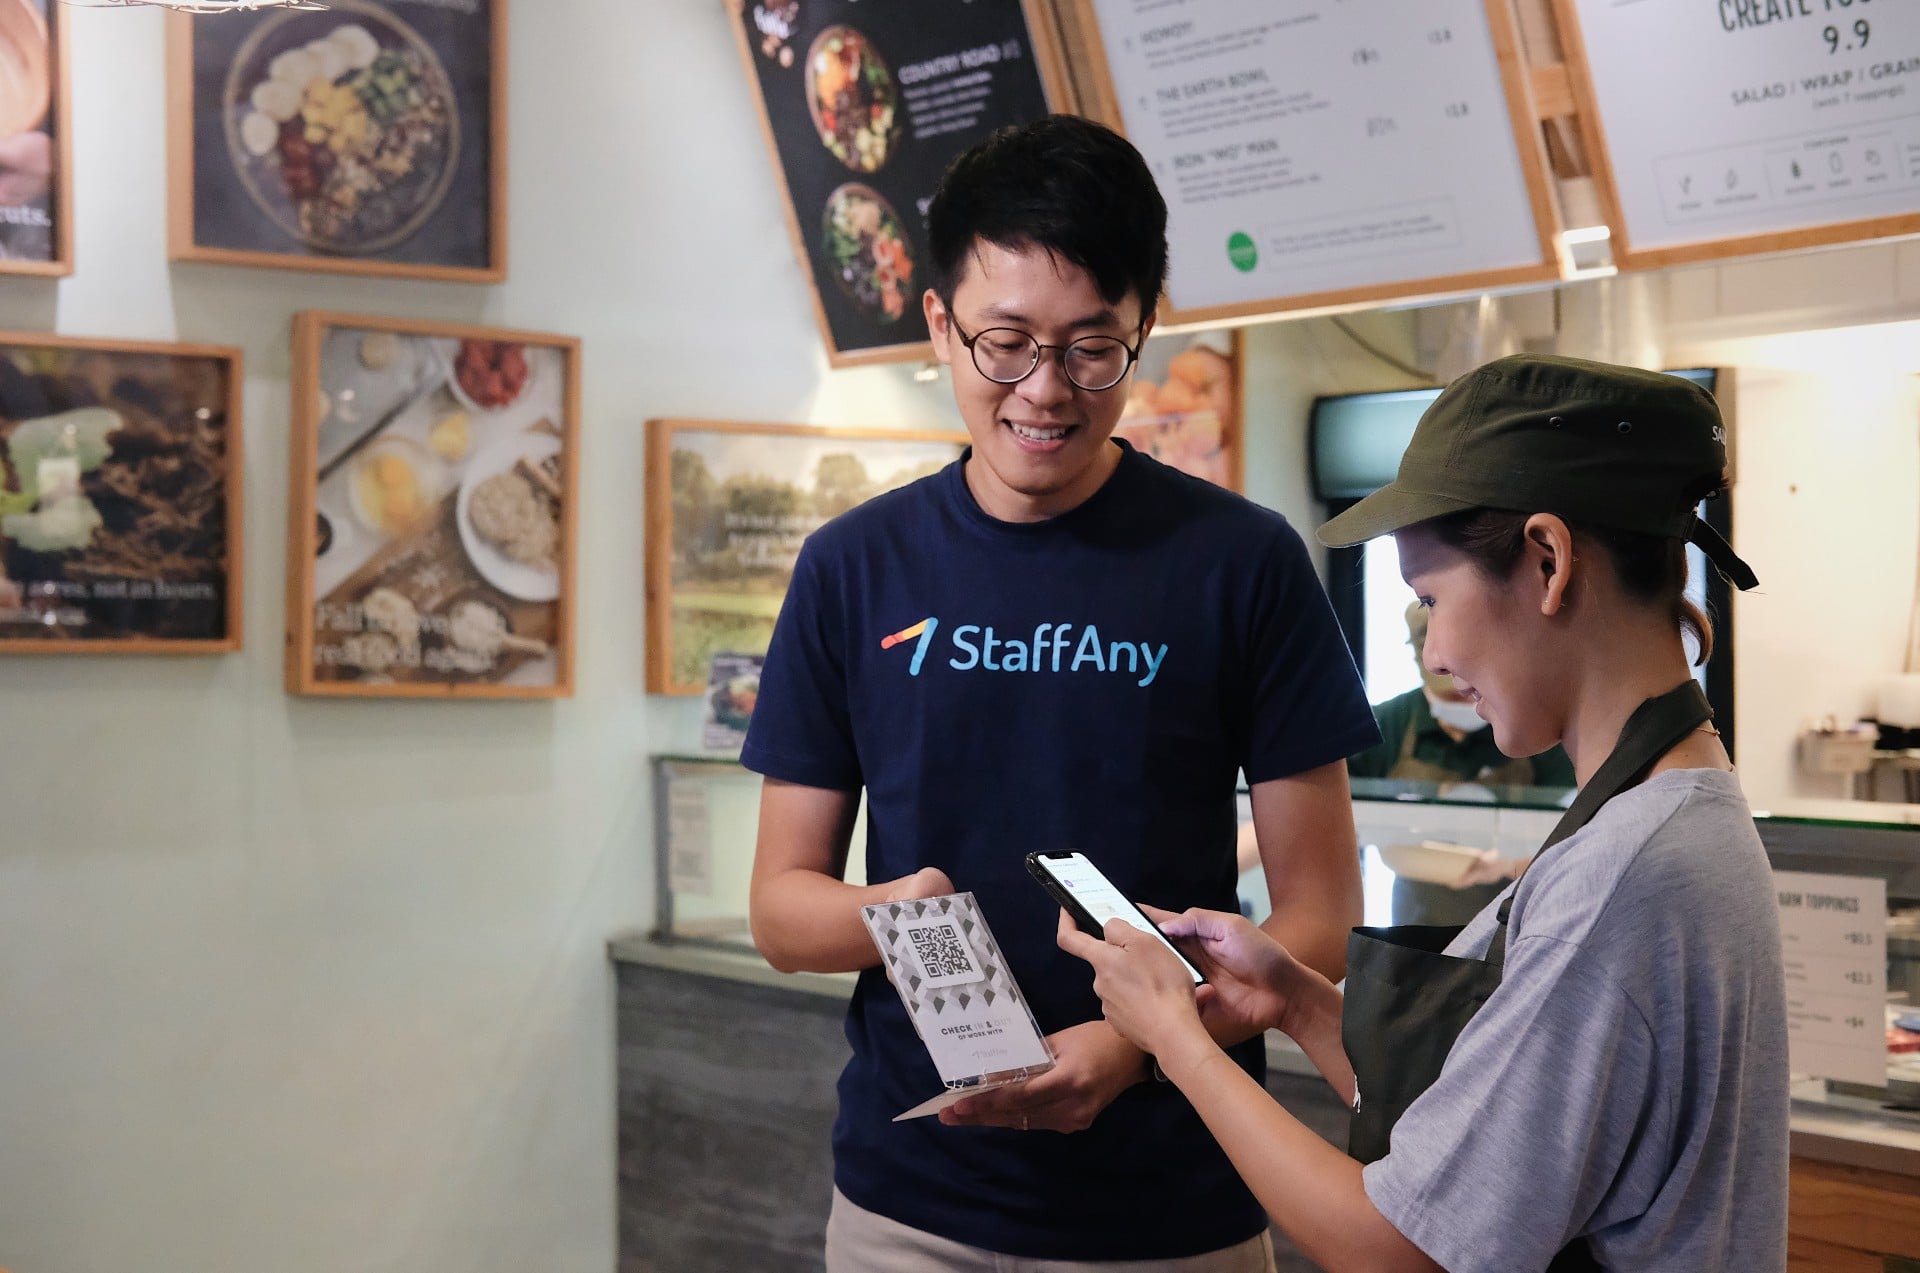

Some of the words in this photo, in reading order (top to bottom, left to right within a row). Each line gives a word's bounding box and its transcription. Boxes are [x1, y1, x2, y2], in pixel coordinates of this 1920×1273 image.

[1822, 18, 1870, 54] 9.9
[1731, 82, 1786, 106] SALAD
[1801, 71, 1853, 91] WRAP
[949, 623, 1169, 687] StaffAny
[941, 1024, 973, 1036] CHECK
[986, 1020, 993, 1028] &
[987, 1028, 1003, 1036] WITH
